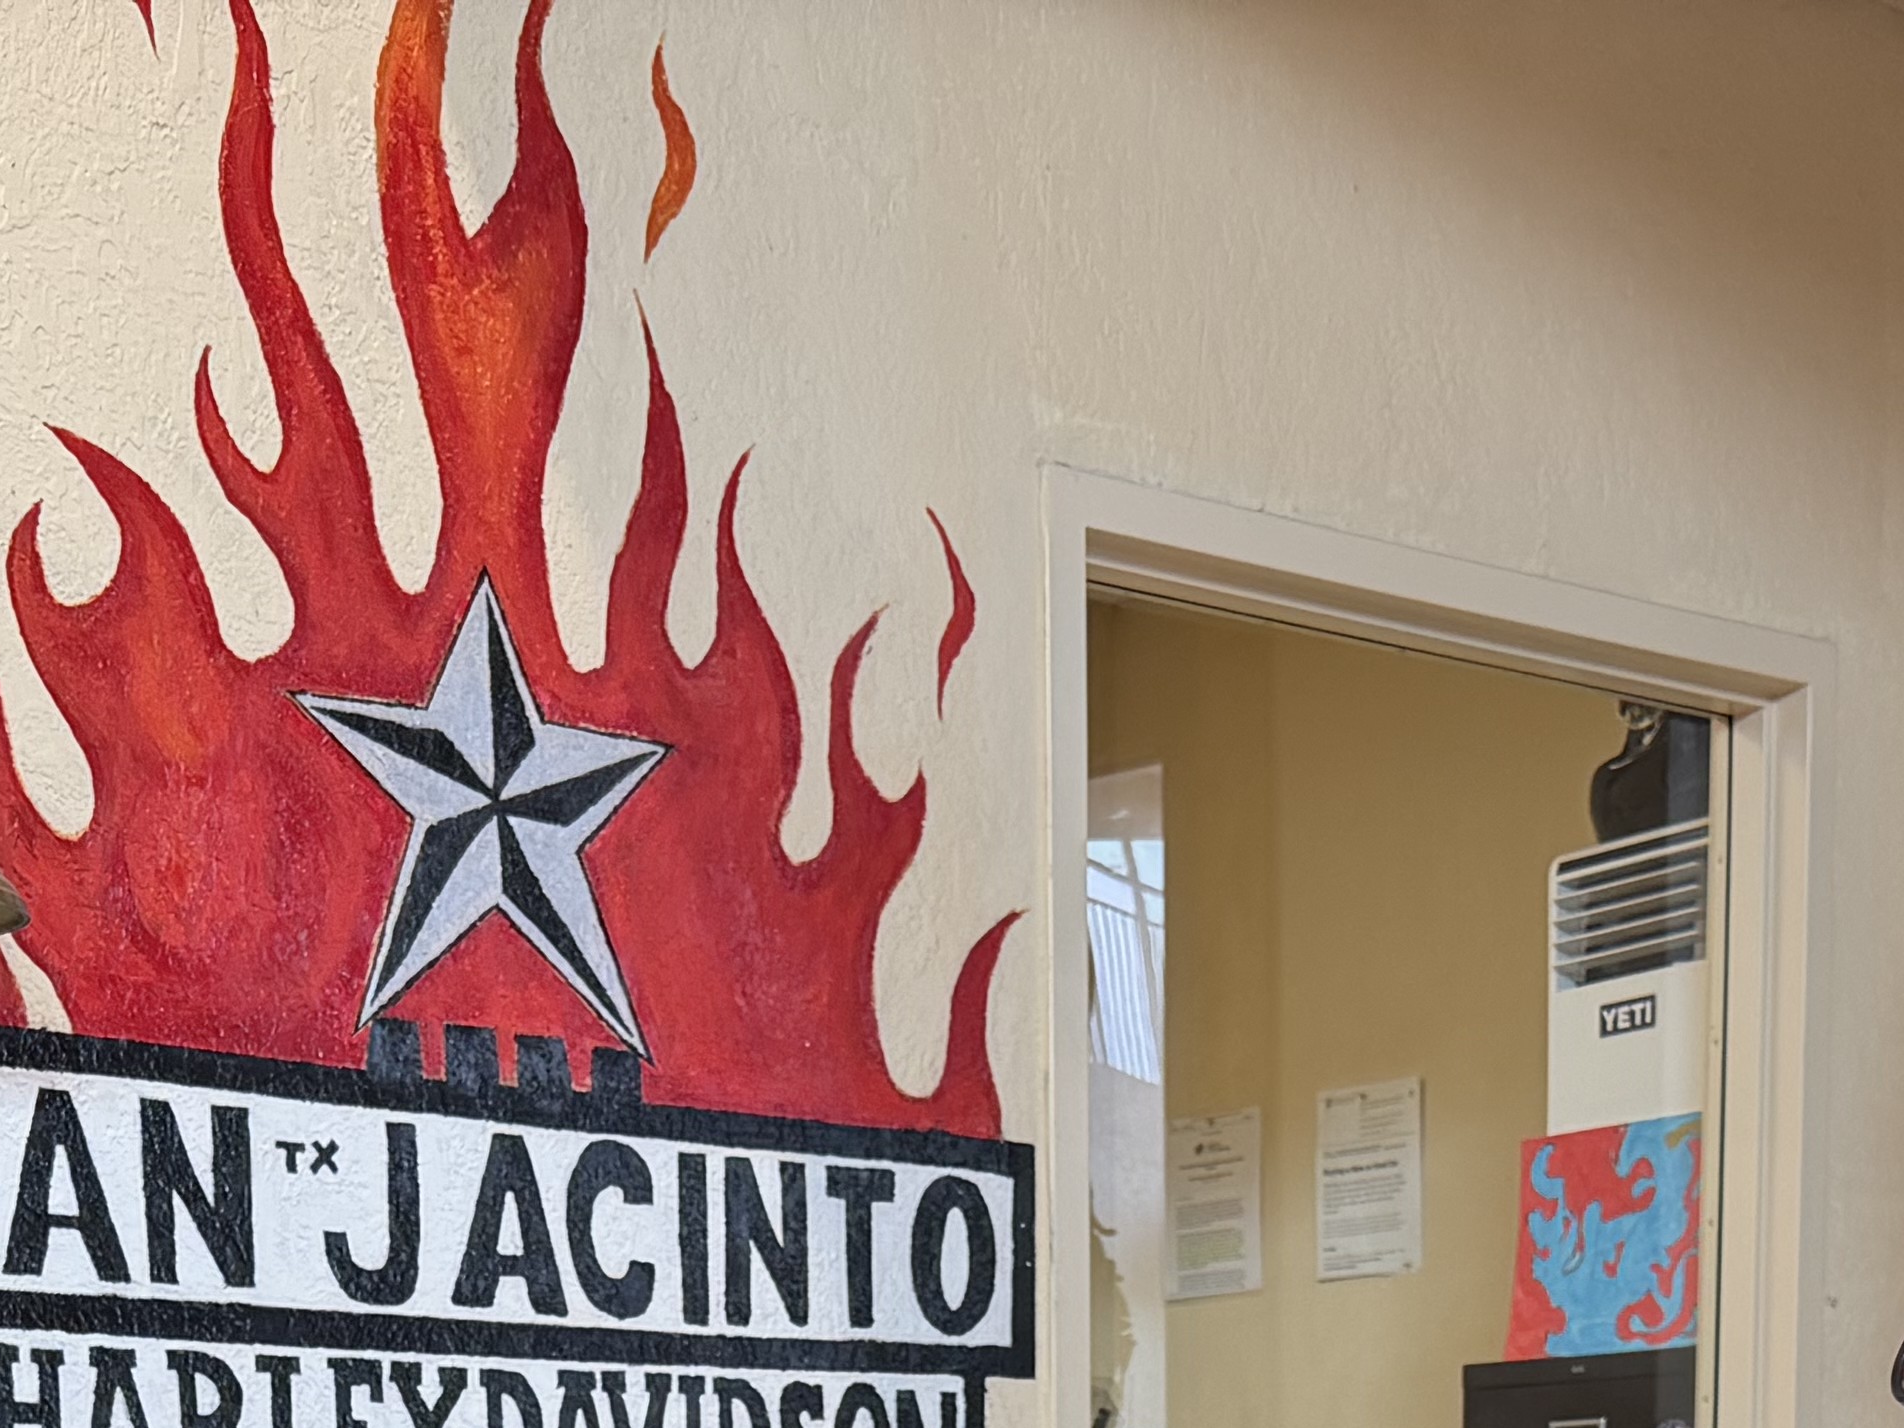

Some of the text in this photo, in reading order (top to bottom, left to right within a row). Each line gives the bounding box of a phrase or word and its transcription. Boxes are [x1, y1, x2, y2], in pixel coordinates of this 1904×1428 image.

[1601, 1000, 1653, 1032] YETI
[276, 1139, 341, 1178] TX
[323, 1121, 1001, 1338] JACINTO
